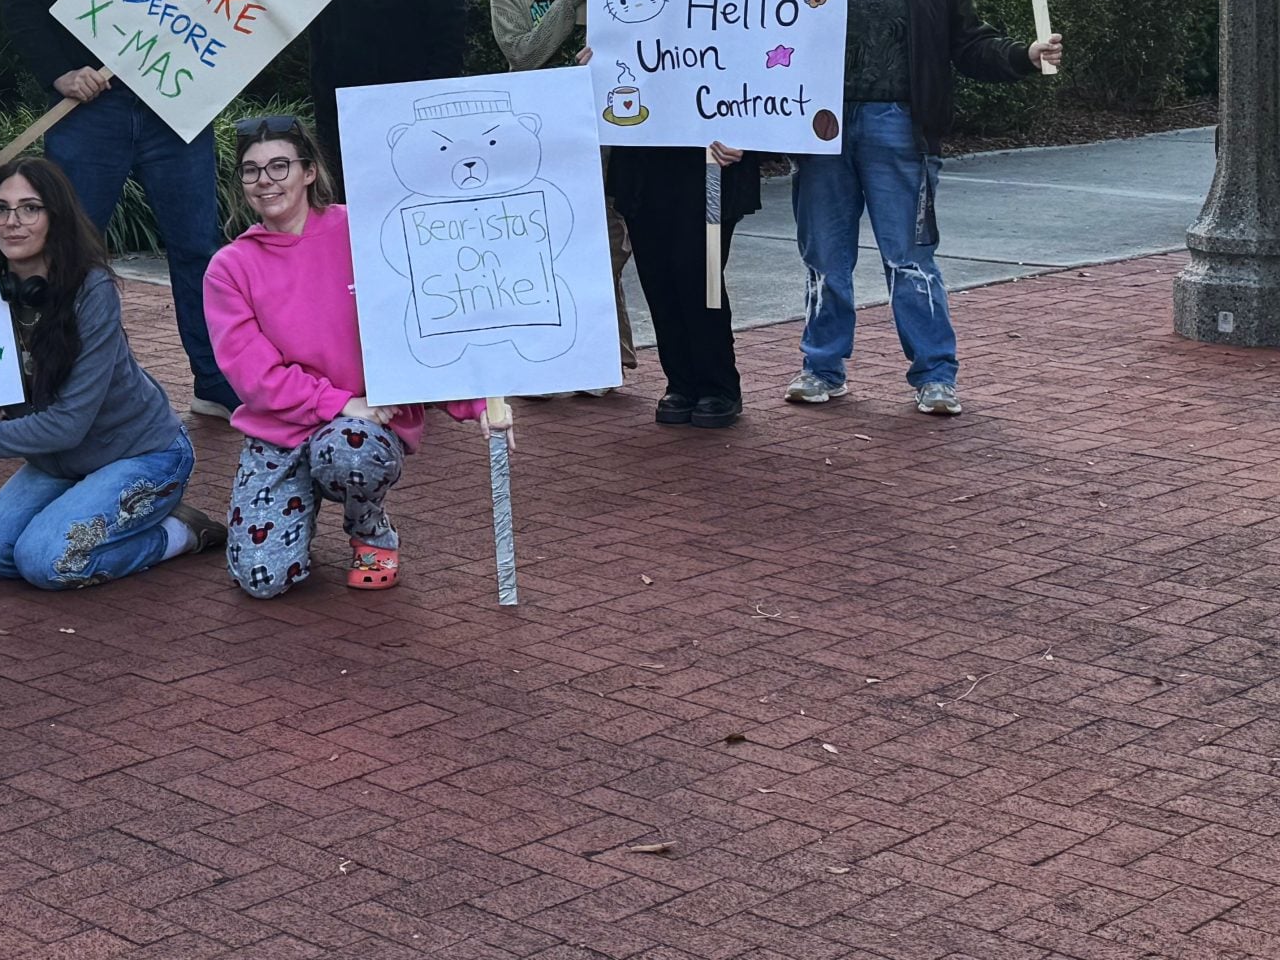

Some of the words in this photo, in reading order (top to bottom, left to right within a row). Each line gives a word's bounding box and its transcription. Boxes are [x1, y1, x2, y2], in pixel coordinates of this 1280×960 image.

[636, 38, 727, 73] Union
[696, 82, 812, 120] Contract
[421, 252, 551, 320] Strike!
